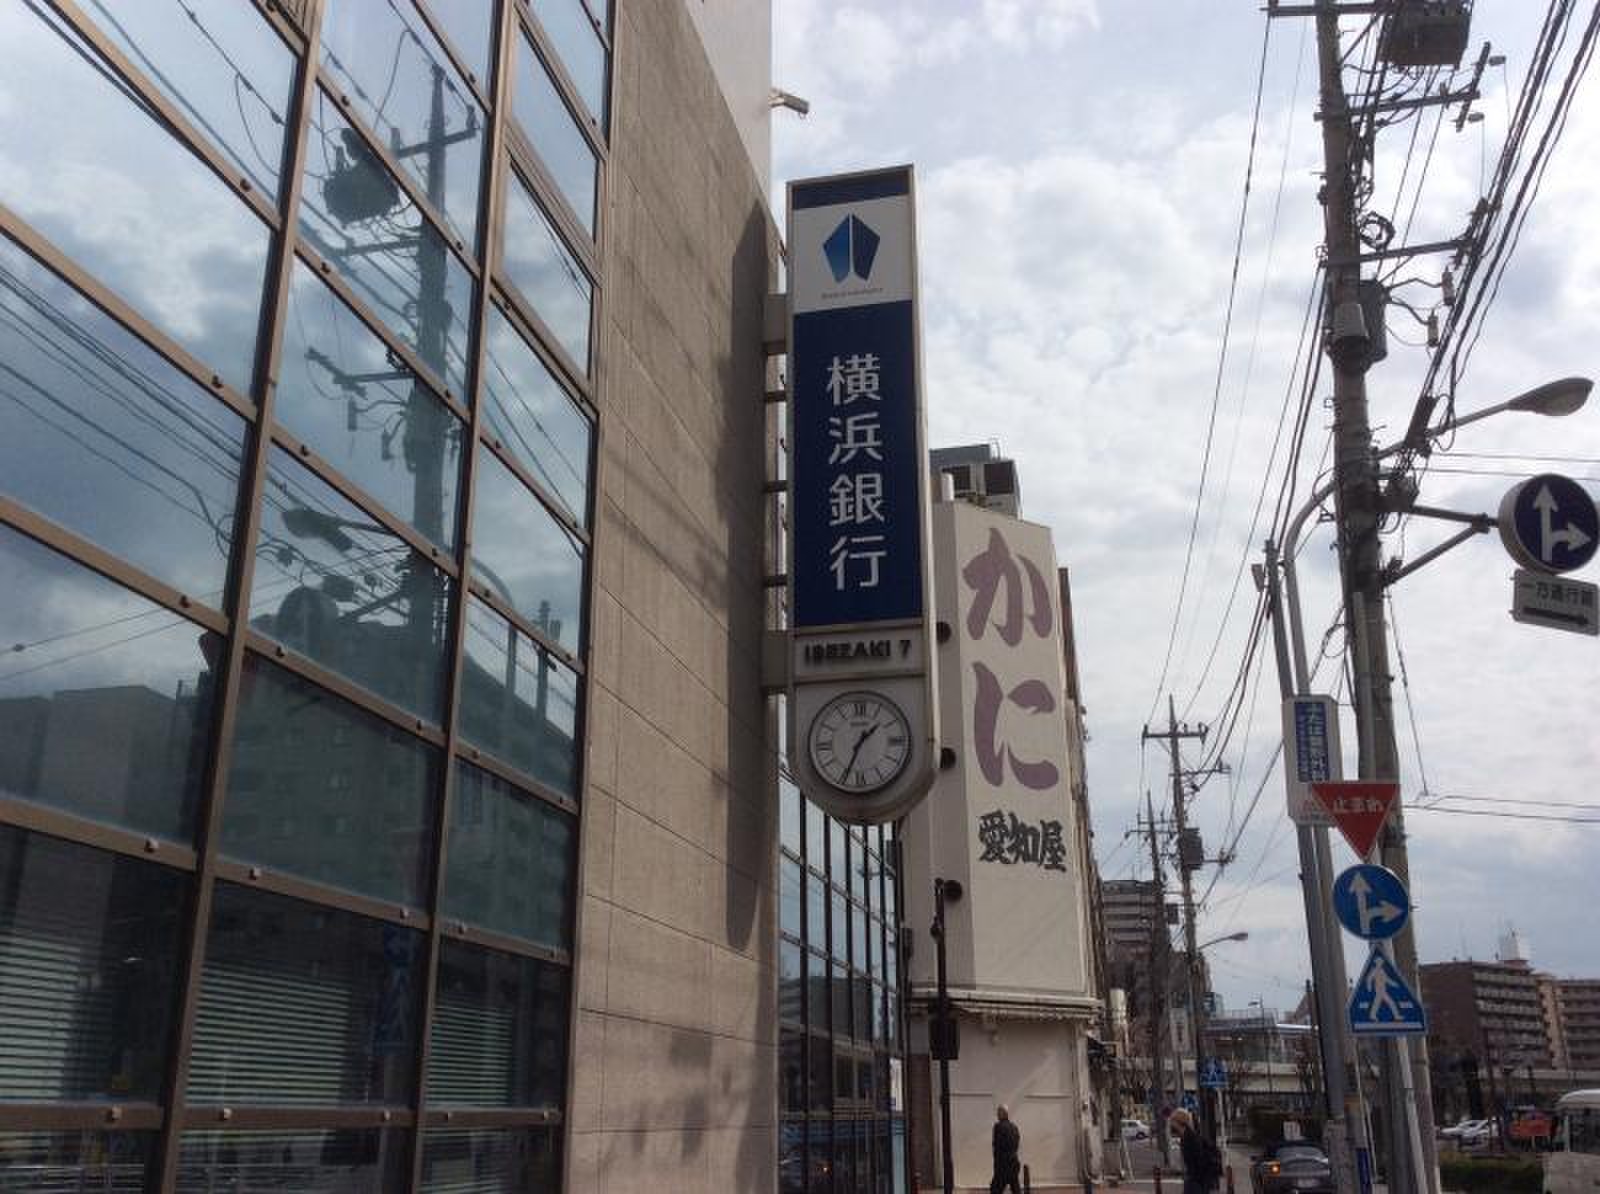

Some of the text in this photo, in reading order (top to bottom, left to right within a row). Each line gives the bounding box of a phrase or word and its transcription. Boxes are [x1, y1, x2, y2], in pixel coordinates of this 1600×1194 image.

[826, 353, 887, 590] 横浜銀行
[899, 639, 911, 659] 7
[962, 527, 1059, 791] かに
[978, 811, 1066, 873] 愛知屋
